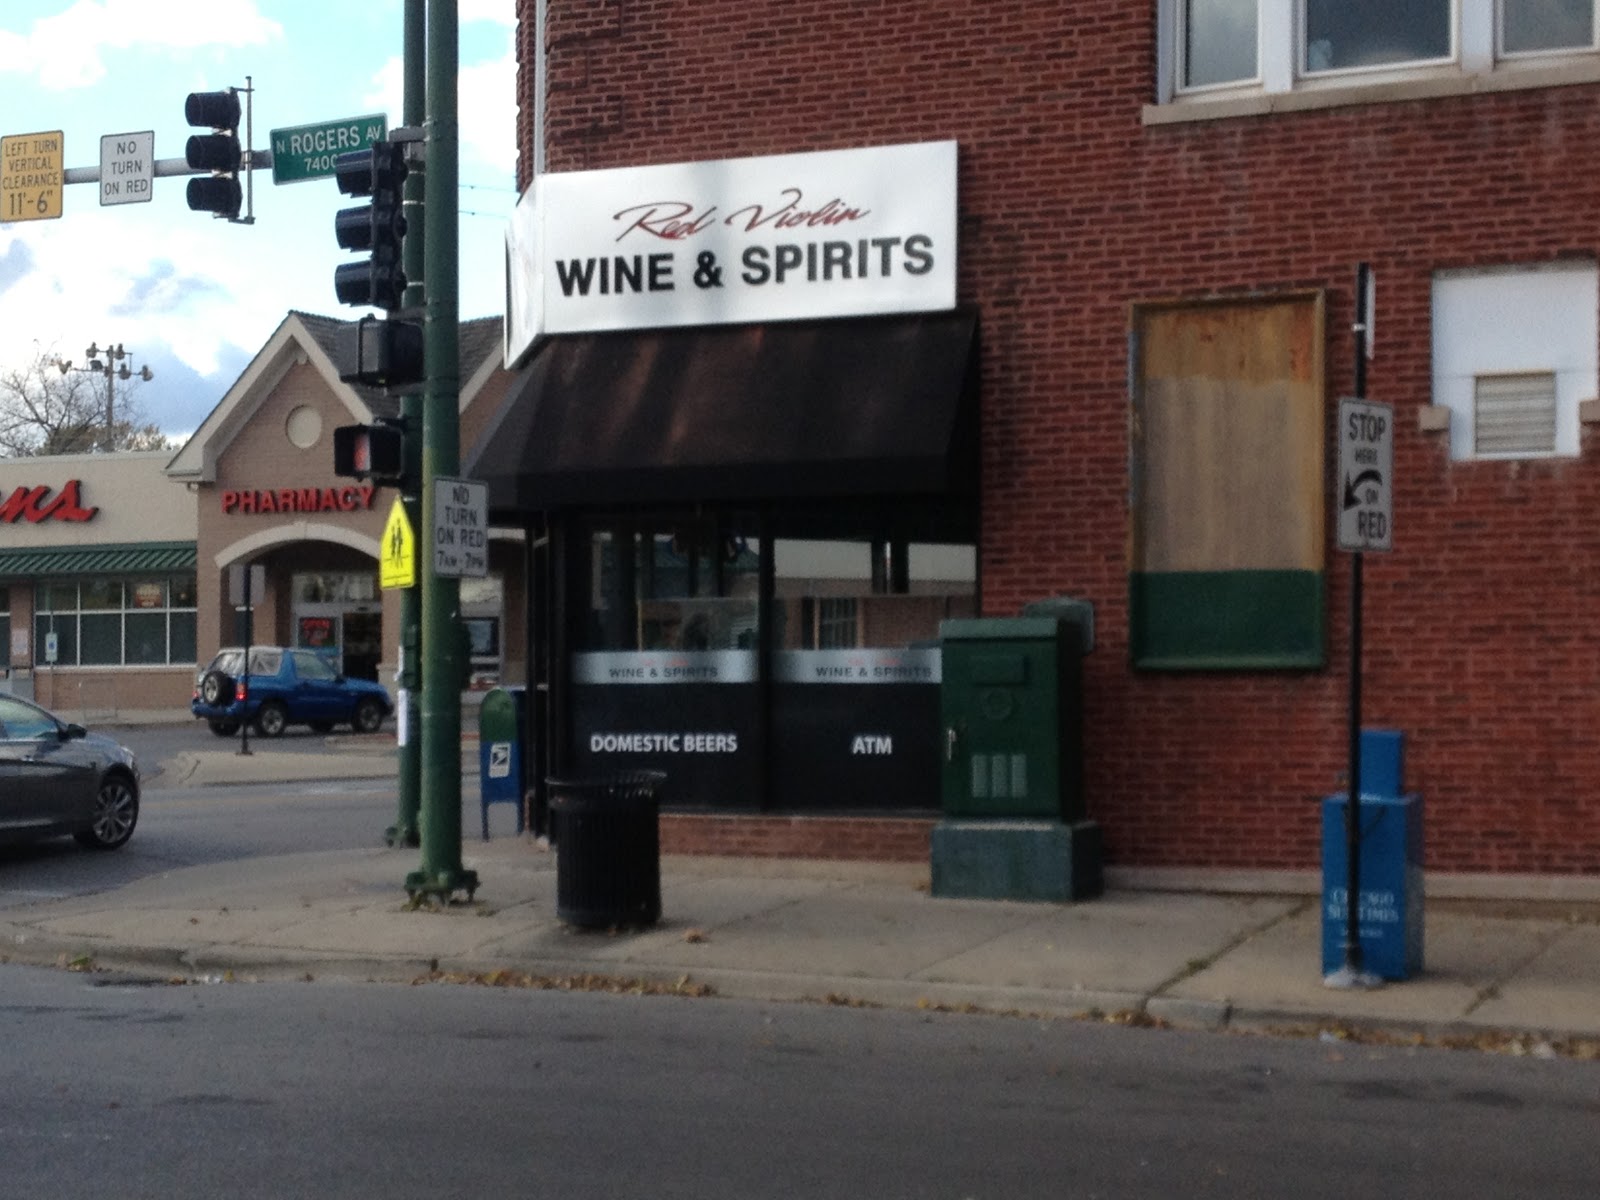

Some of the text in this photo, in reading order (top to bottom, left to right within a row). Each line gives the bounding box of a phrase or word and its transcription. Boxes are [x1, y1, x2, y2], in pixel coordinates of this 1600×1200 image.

[5, 139, 58, 157] LEFT TURN
[117, 140, 137, 155] NO
[276, 125, 382, 156] N ROGERS AV
[8, 156, 54, 173] VERTICAL
[111, 159, 143, 175] TURN
[2, 172, 59, 190] CLEARANCE
[104, 178, 148, 196] ON RED
[613, 188, 871, 242] Red Violin
[556, 234, 935, 297] WINE & SPIRITS
[1349, 412, 1387, 443] STOP
[221, 484, 376, 514] PHARMACY
[452, 485, 470, 505] NO
[445, 505, 478, 526] TURN
[1358, 511, 1387, 539] RED
[437, 527, 484, 548] ON RED
[609, 667, 645, 679] WINE
[663, 666, 718, 679] SPIRITS
[815, 666, 853, 678] WINE
[590, 733, 738, 753] DOMESTIC BEERS
[852, 736, 893, 756] ATM
